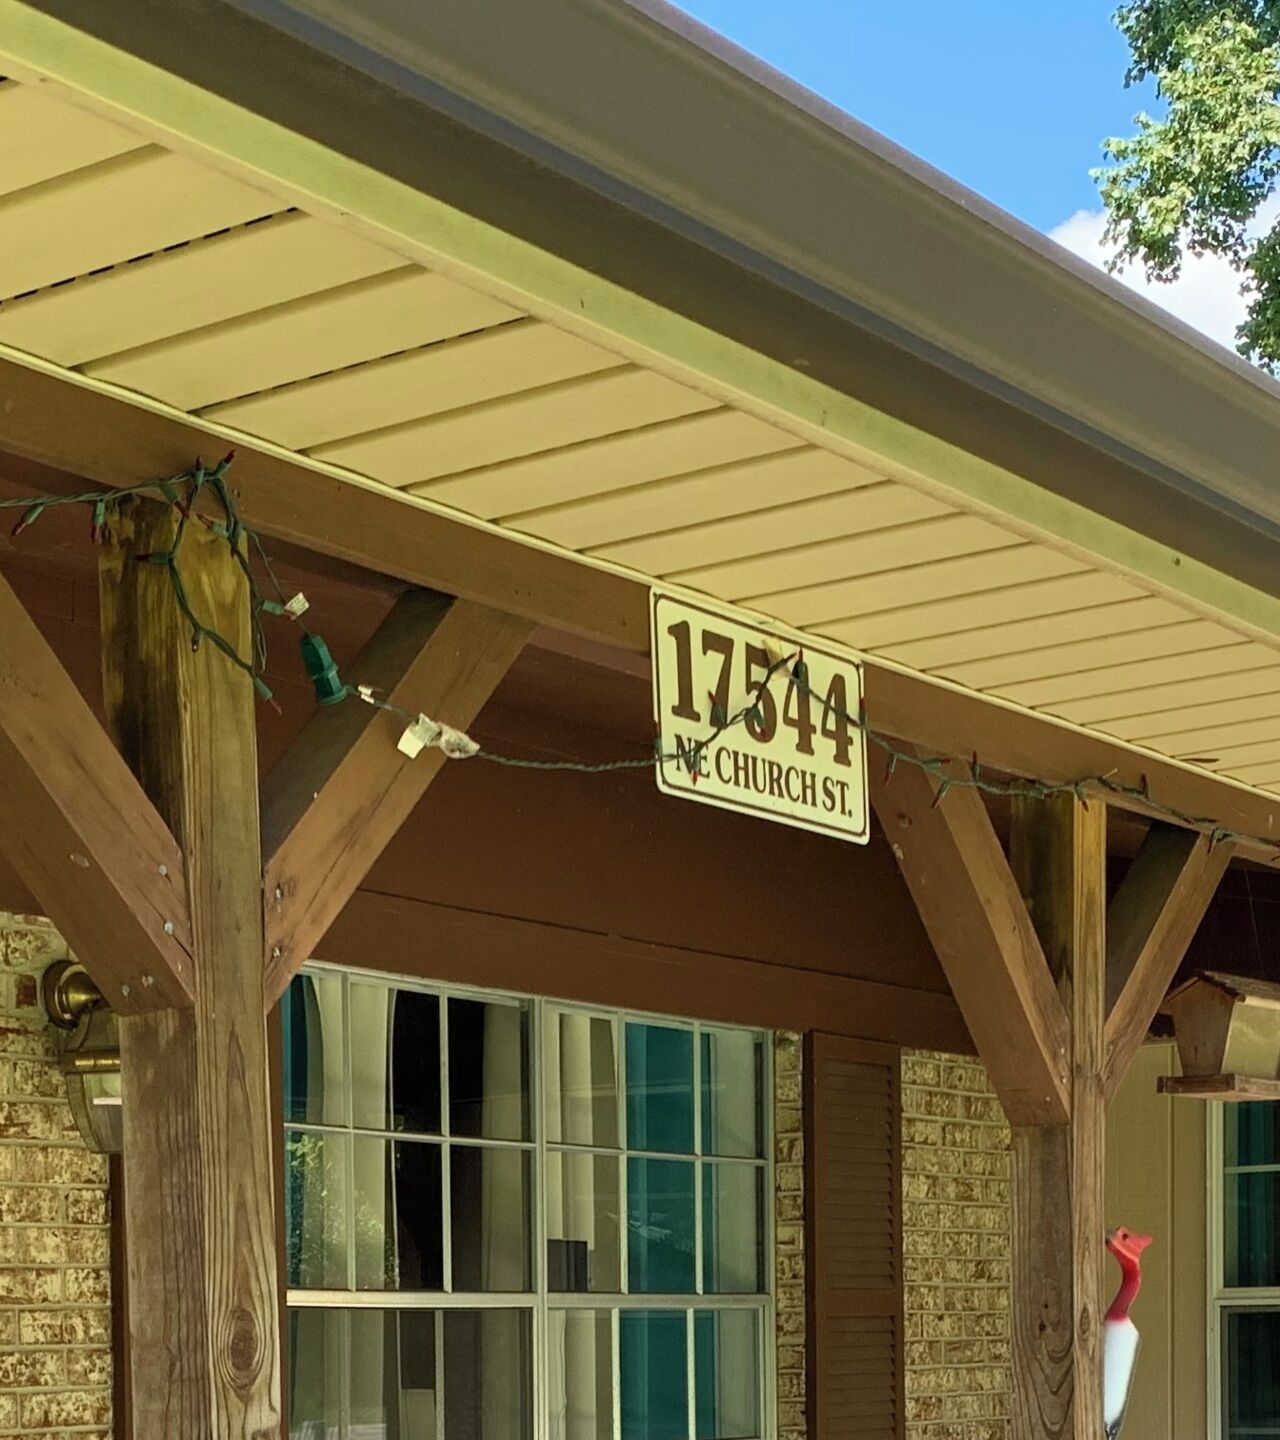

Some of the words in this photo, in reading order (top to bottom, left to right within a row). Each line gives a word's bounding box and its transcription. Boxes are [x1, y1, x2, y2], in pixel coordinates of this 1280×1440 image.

[666, 619, 854, 768] 17544
[674, 733, 710, 779] NE
[715, 746, 818, 809] CHURCH
[822, 775, 853, 818] ST.
